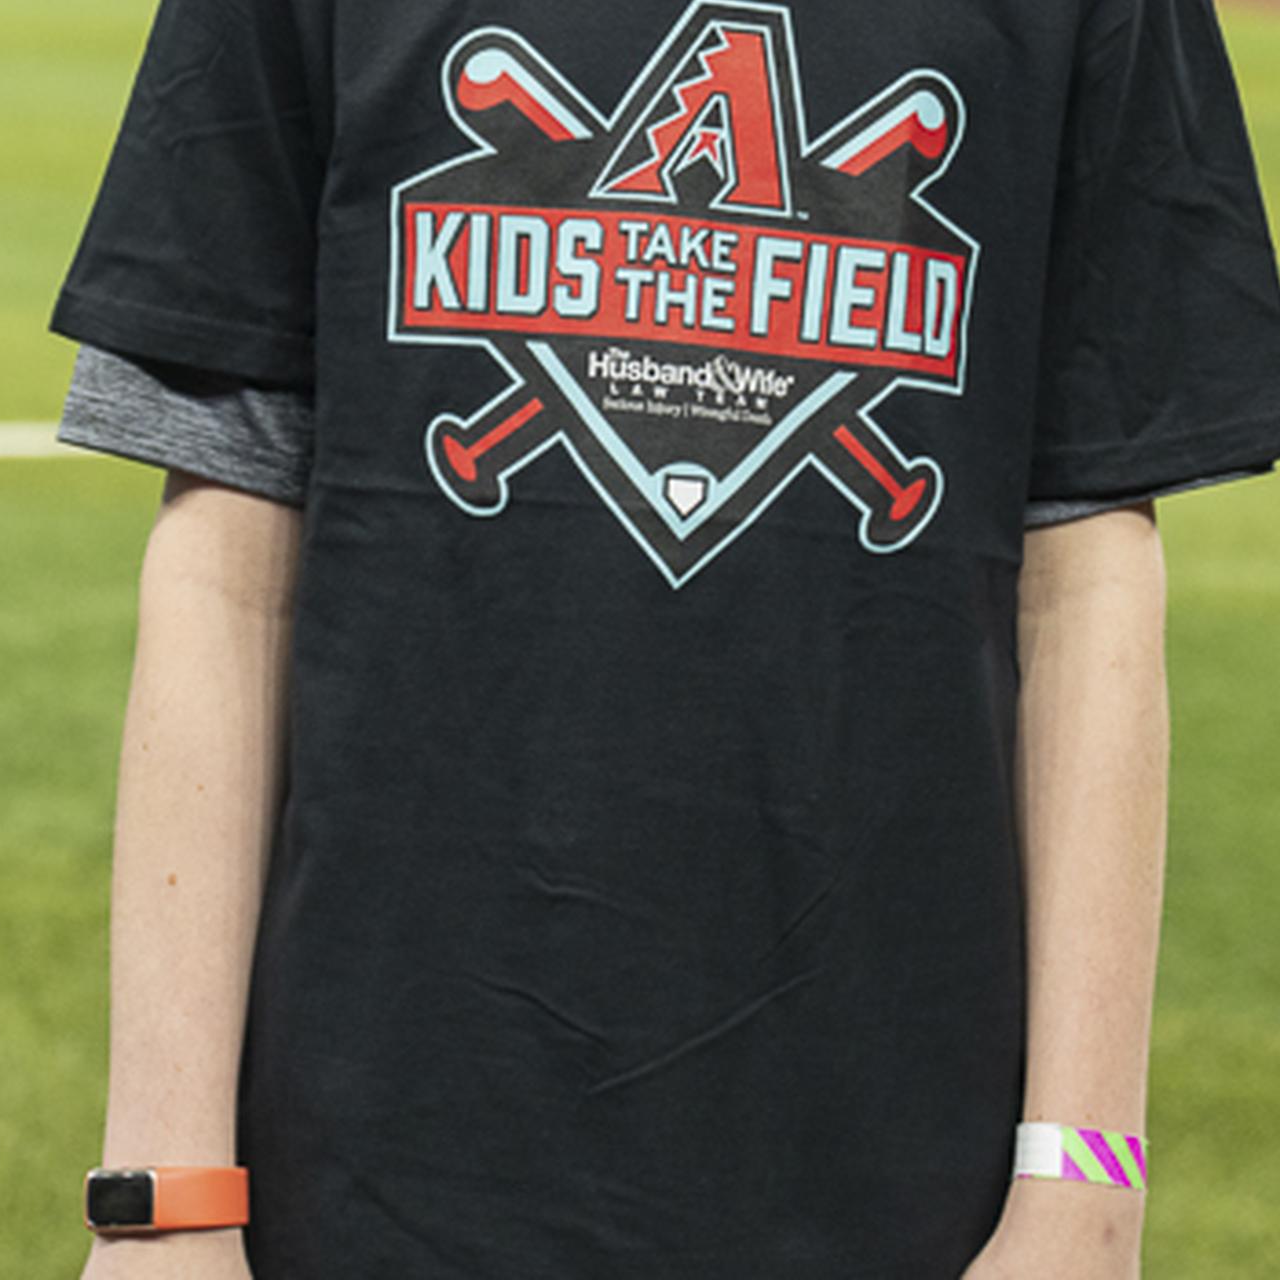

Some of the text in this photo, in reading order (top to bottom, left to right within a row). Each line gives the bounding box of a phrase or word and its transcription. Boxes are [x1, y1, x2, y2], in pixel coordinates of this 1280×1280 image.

[413, 211, 957, 358] KIDS TAKE THE FIELD
[609, 383, 769, 410] LAW TEAM
